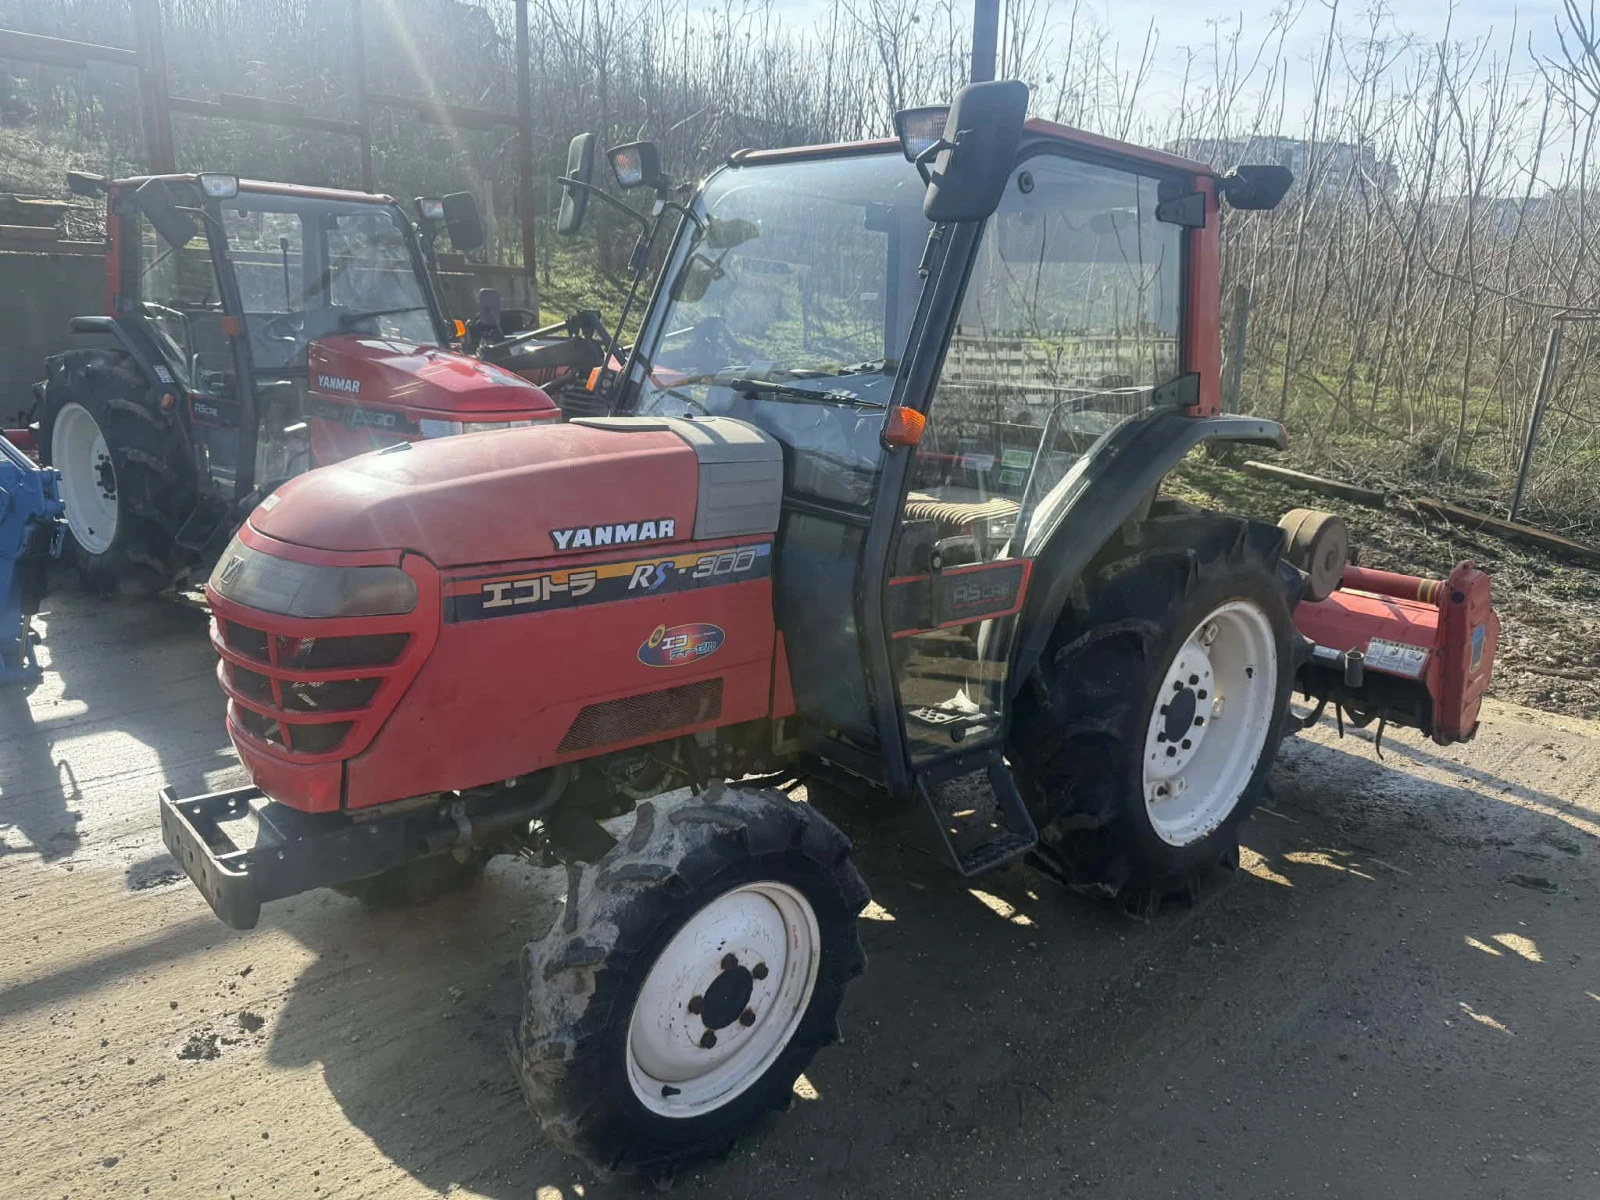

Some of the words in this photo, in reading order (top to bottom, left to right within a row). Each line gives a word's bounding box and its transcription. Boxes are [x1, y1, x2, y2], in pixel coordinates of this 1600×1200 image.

[318, 375, 361, 394] YANMAR
[552, 518, 676, 550] YANMAR
[482, 571, 597, 609] エコトラ
[662, 634, 688, 650] エコ
